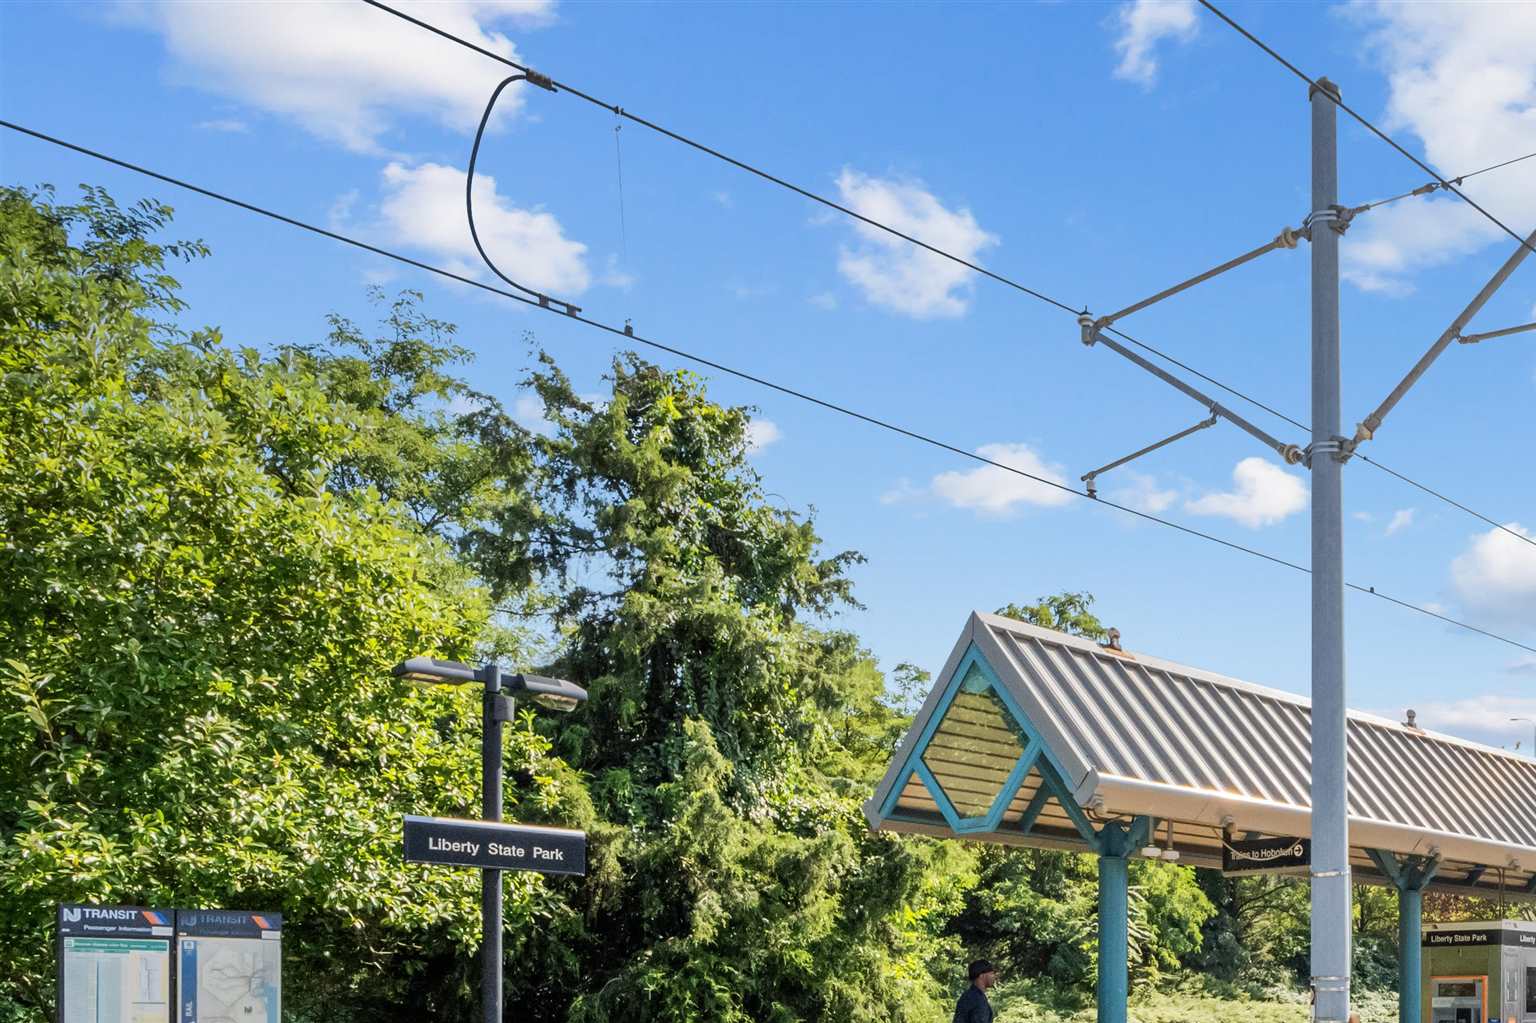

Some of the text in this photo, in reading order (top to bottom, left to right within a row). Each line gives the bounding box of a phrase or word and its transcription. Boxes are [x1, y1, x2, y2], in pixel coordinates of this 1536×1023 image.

[428, 837, 564, 861] Liberty State Park
[63, 908, 139, 922] NJ TRANSIT
[1431, 933, 1487, 943] Liberty State Park
[1520, 935, 1536, 944] Liberty
